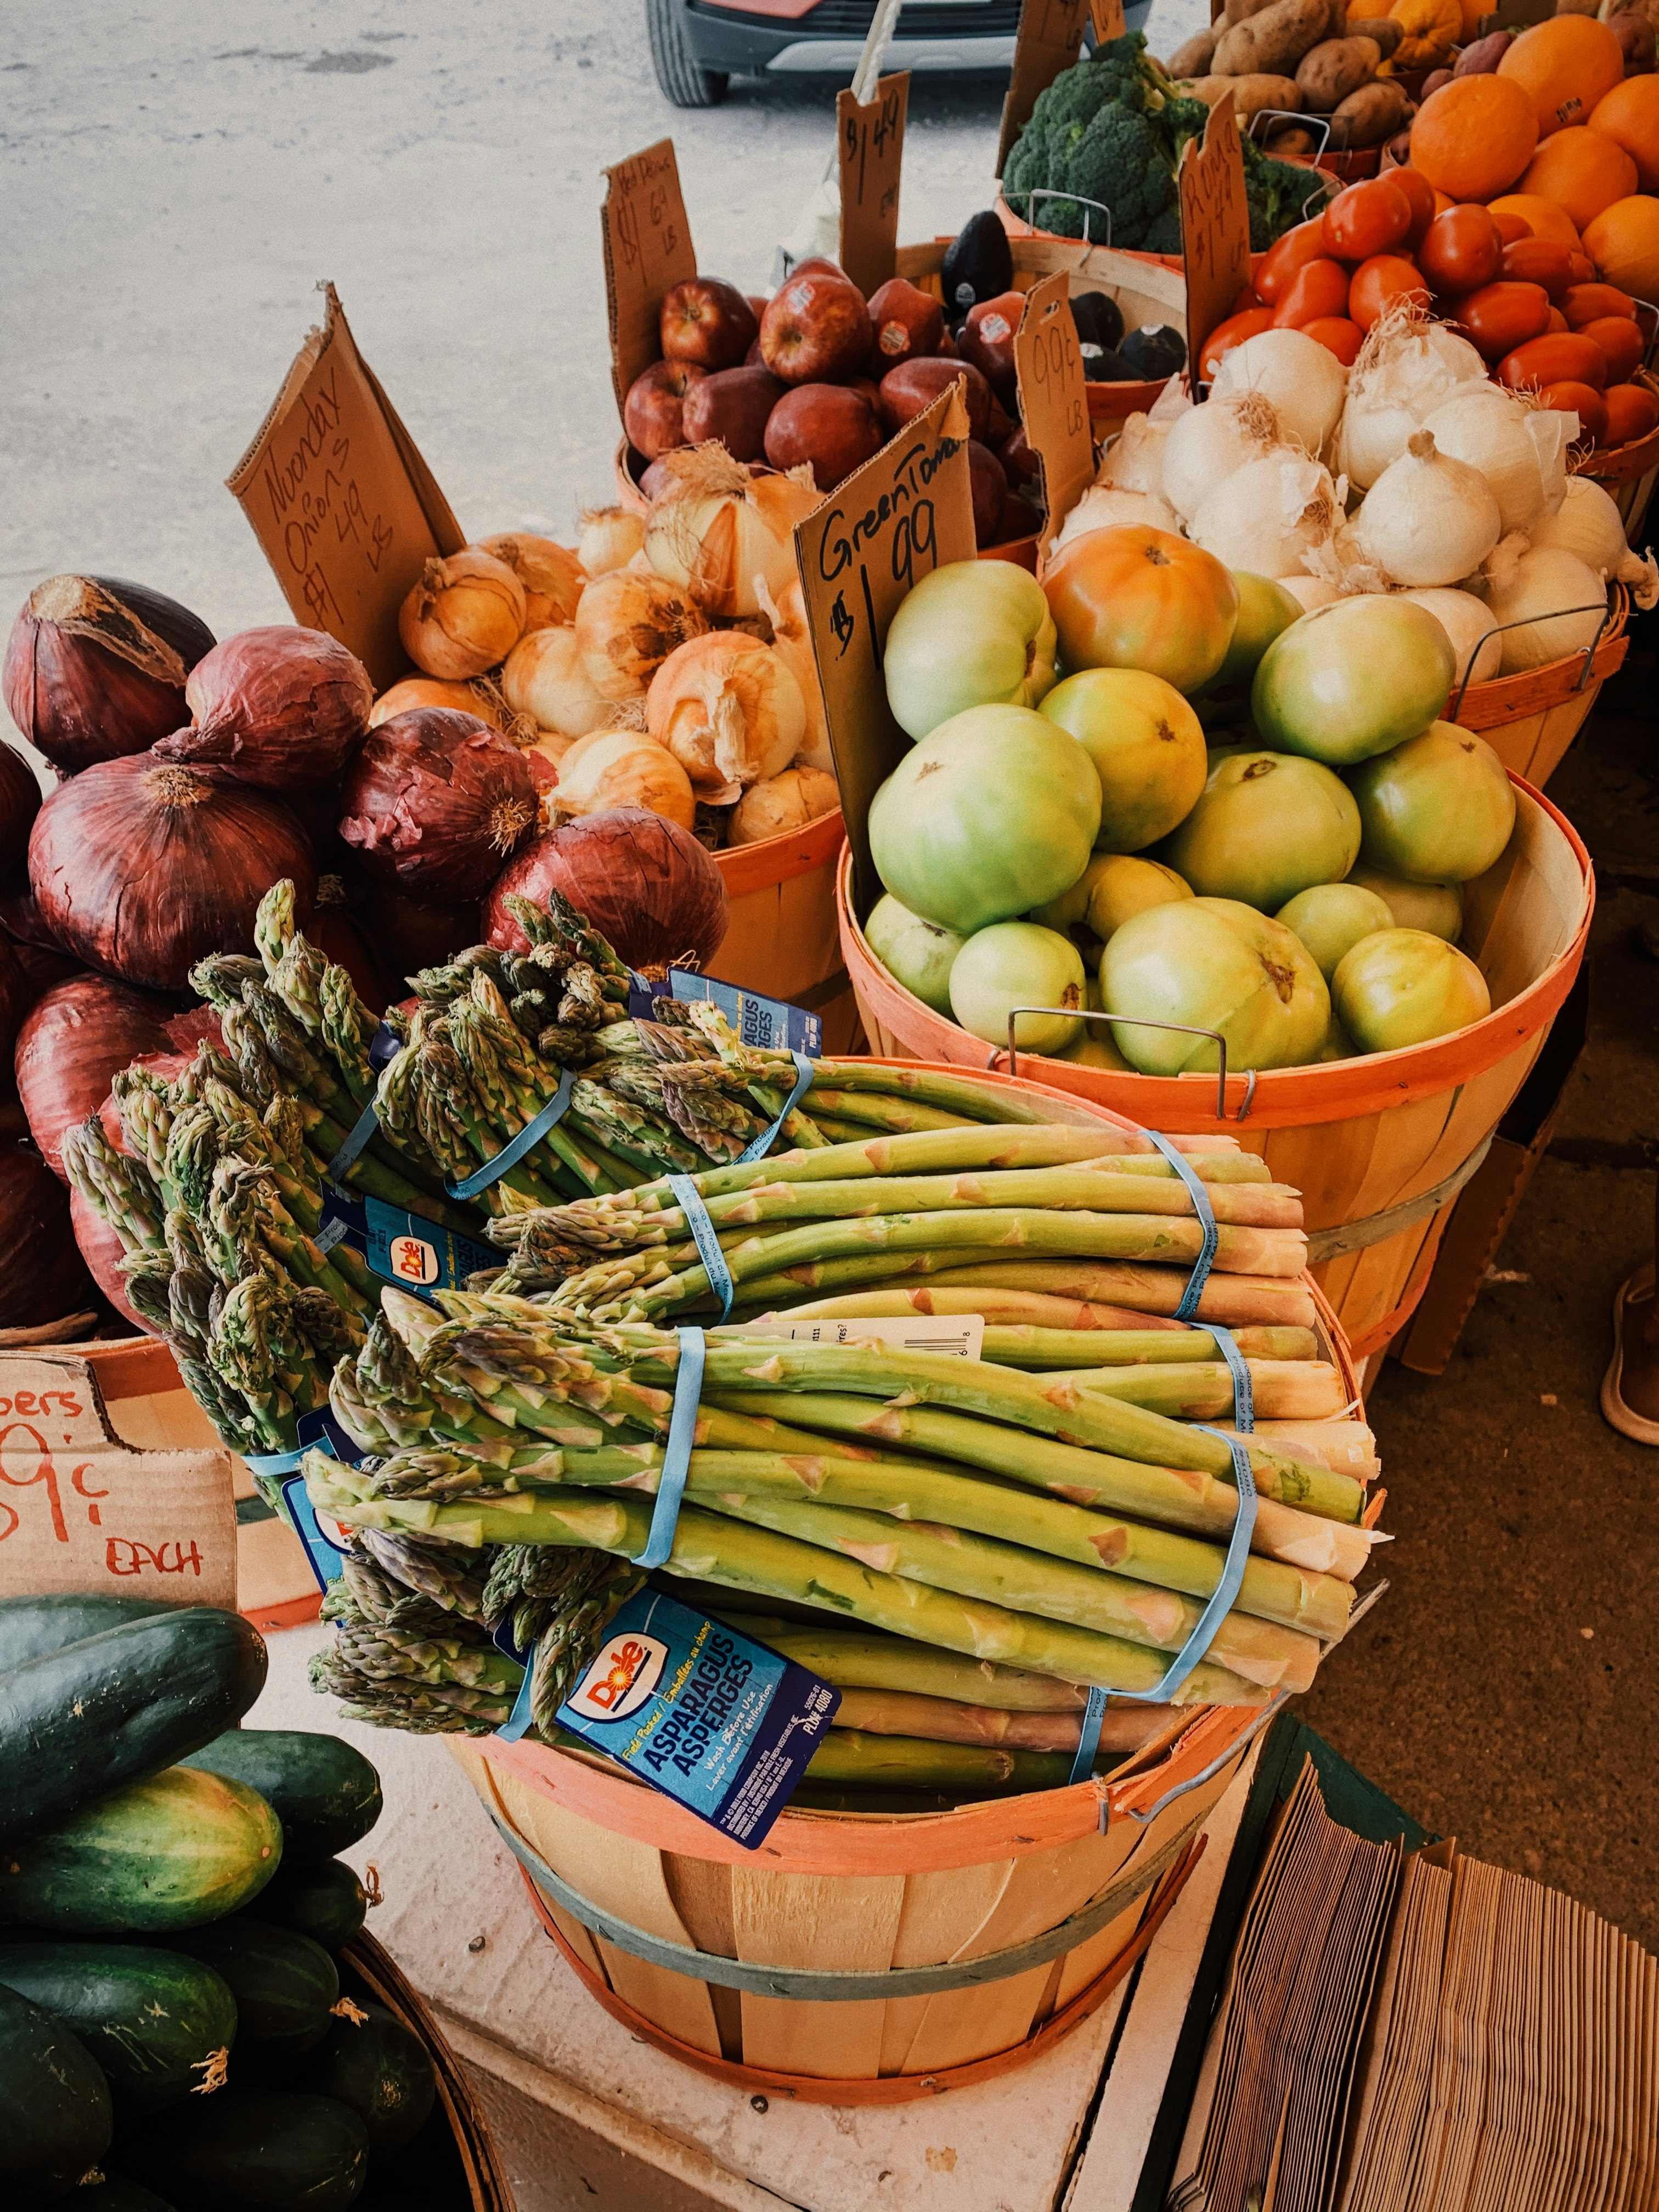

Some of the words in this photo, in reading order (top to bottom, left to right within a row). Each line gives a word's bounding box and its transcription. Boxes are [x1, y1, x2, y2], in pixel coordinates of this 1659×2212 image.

[284, 438, 349, 575] Onions
[820, 483, 910, 582] Green
[894, 437, 968, 493] Toma
[399, 1241, 421, 1278] Dole
[106, 1538, 203, 1576] EACH
[586, 1641, 642, 1709] Dole
[622, 1738, 642, 1762] Field
[637, 1709, 663, 1740] Packed
[663, 1659, 693, 1703] Emballées
[691, 1647, 699, 1658] au
[696, 1622, 714, 1646] champ
[642, 1631, 736, 1773] ASPARAGUS
[815, 1689, 832, 1712] 4080
[671, 1652, 755, 1777] ASPERGES
[704, 1746, 725, 1769] Wash
[721, 1712, 744, 1746] Before
[742, 1691, 755, 1709] Use
[706, 1764, 726, 1791] Laver
[726, 1736, 743, 1763] avant
